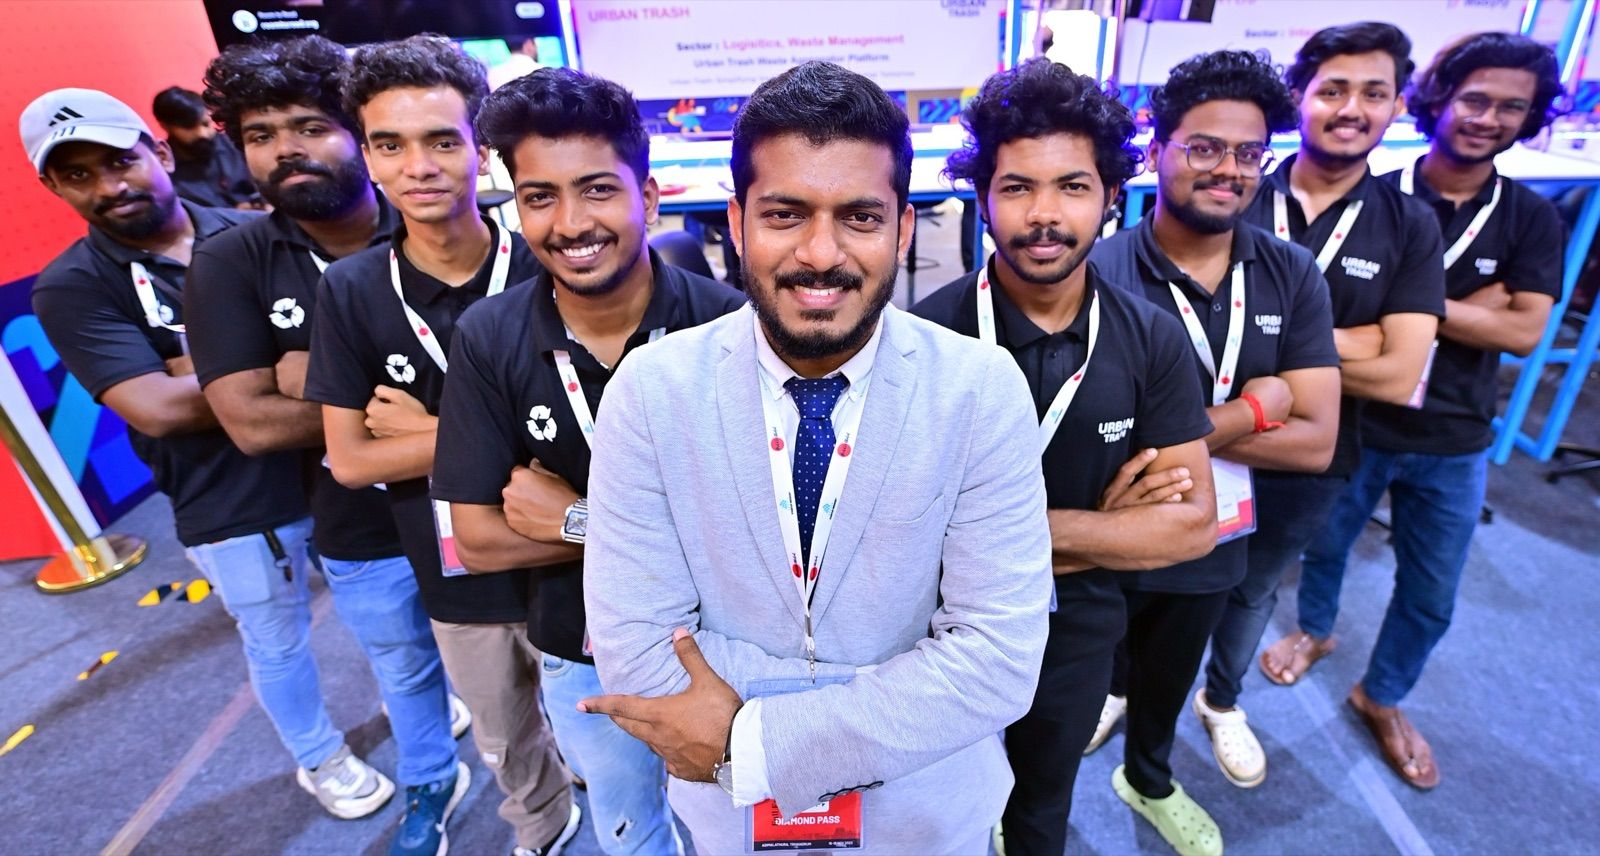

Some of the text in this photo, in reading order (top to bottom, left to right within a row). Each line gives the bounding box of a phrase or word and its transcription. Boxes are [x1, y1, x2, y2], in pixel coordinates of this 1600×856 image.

[588, 6, 690, 22] URBAN TRASH
[676, 42, 712, 51] Sector
[788, 37, 824, 47] Waste
[828, 34, 905, 47] Management
[693, 59, 724, 68] Urban
[1341, 256, 1381, 274] URBAN
[817, 815, 841, 825] PASS
